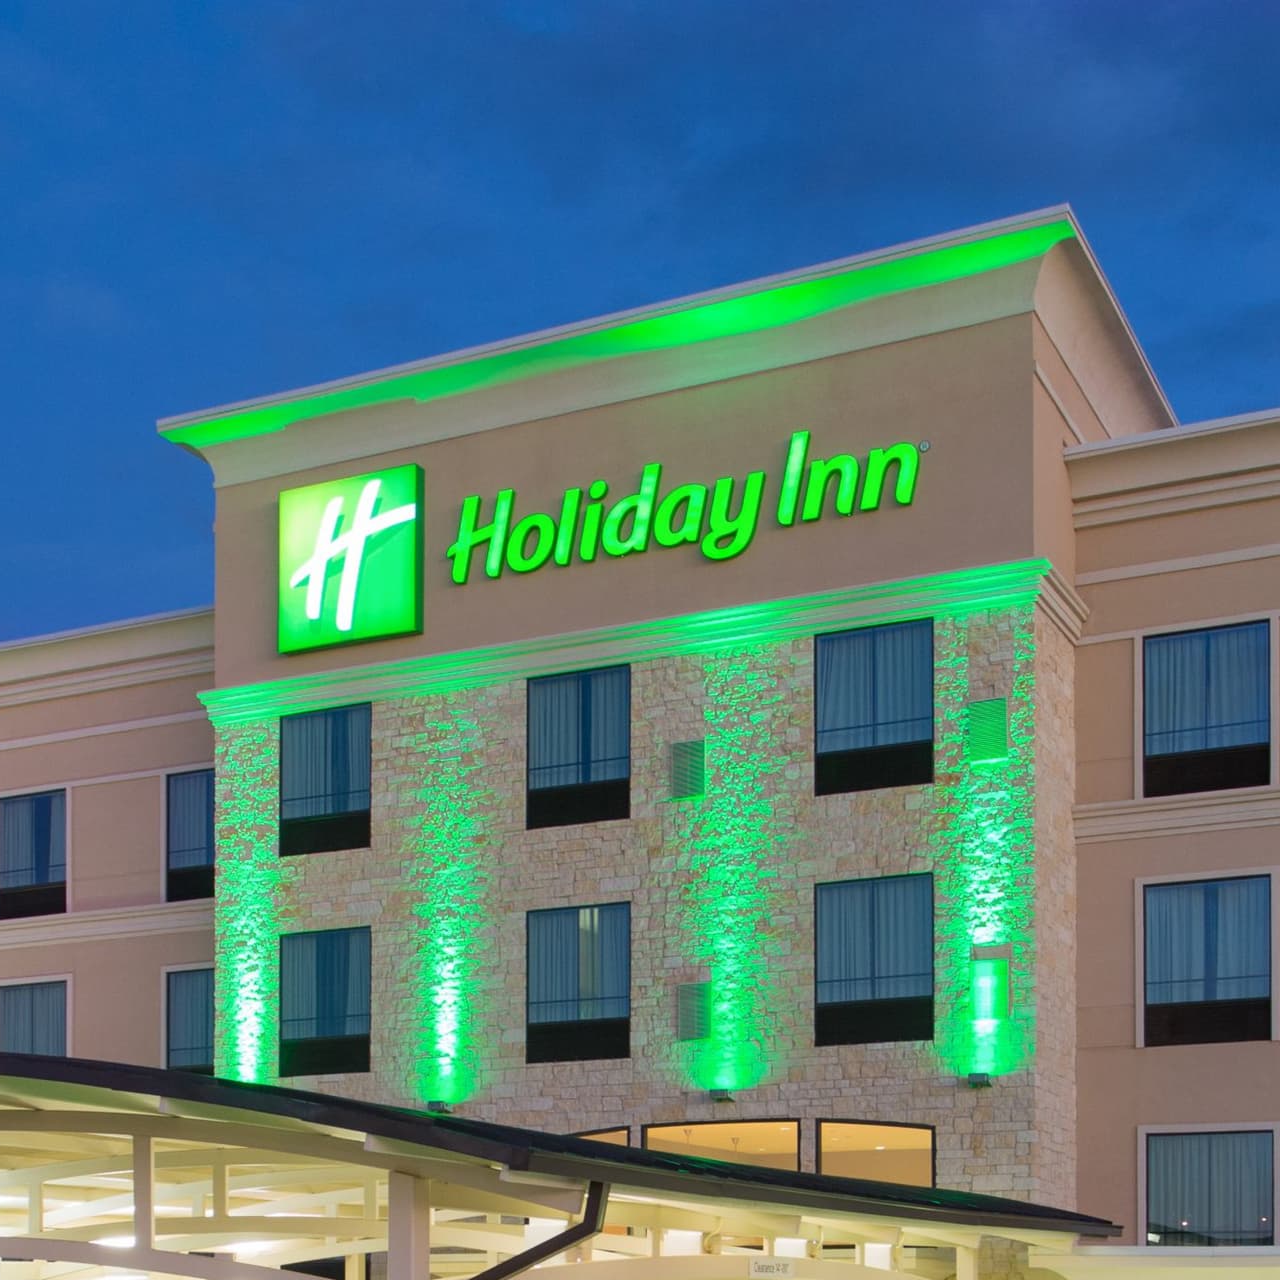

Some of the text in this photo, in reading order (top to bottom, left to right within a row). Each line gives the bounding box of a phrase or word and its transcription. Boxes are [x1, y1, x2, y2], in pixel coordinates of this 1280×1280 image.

[289, 477, 417, 632] H
[446, 430, 920, 585] Holiday Inn
